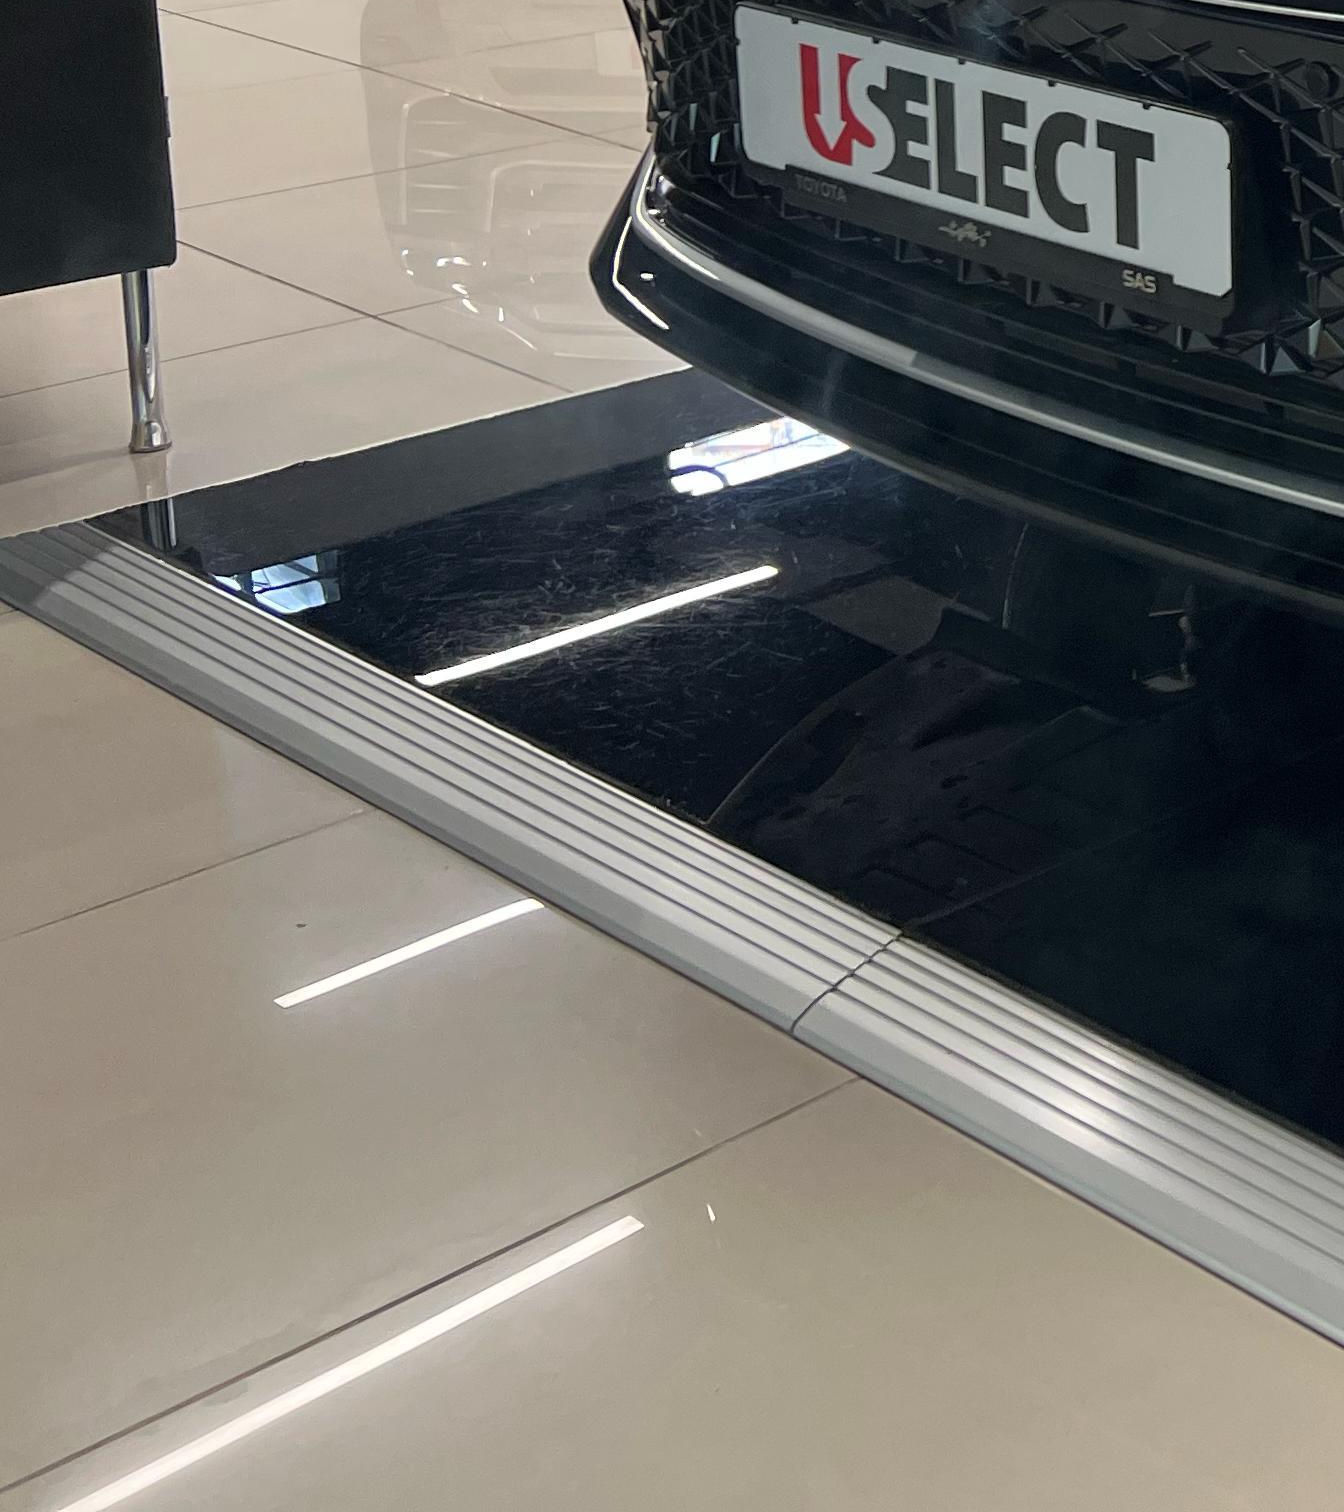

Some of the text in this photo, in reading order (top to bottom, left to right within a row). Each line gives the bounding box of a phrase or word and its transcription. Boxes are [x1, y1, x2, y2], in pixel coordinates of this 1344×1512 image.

[798, 42, 1155, 251] USELECT
[795, 173, 848, 203] TOYOTA
[1122, 269, 1157, 293] SAS
